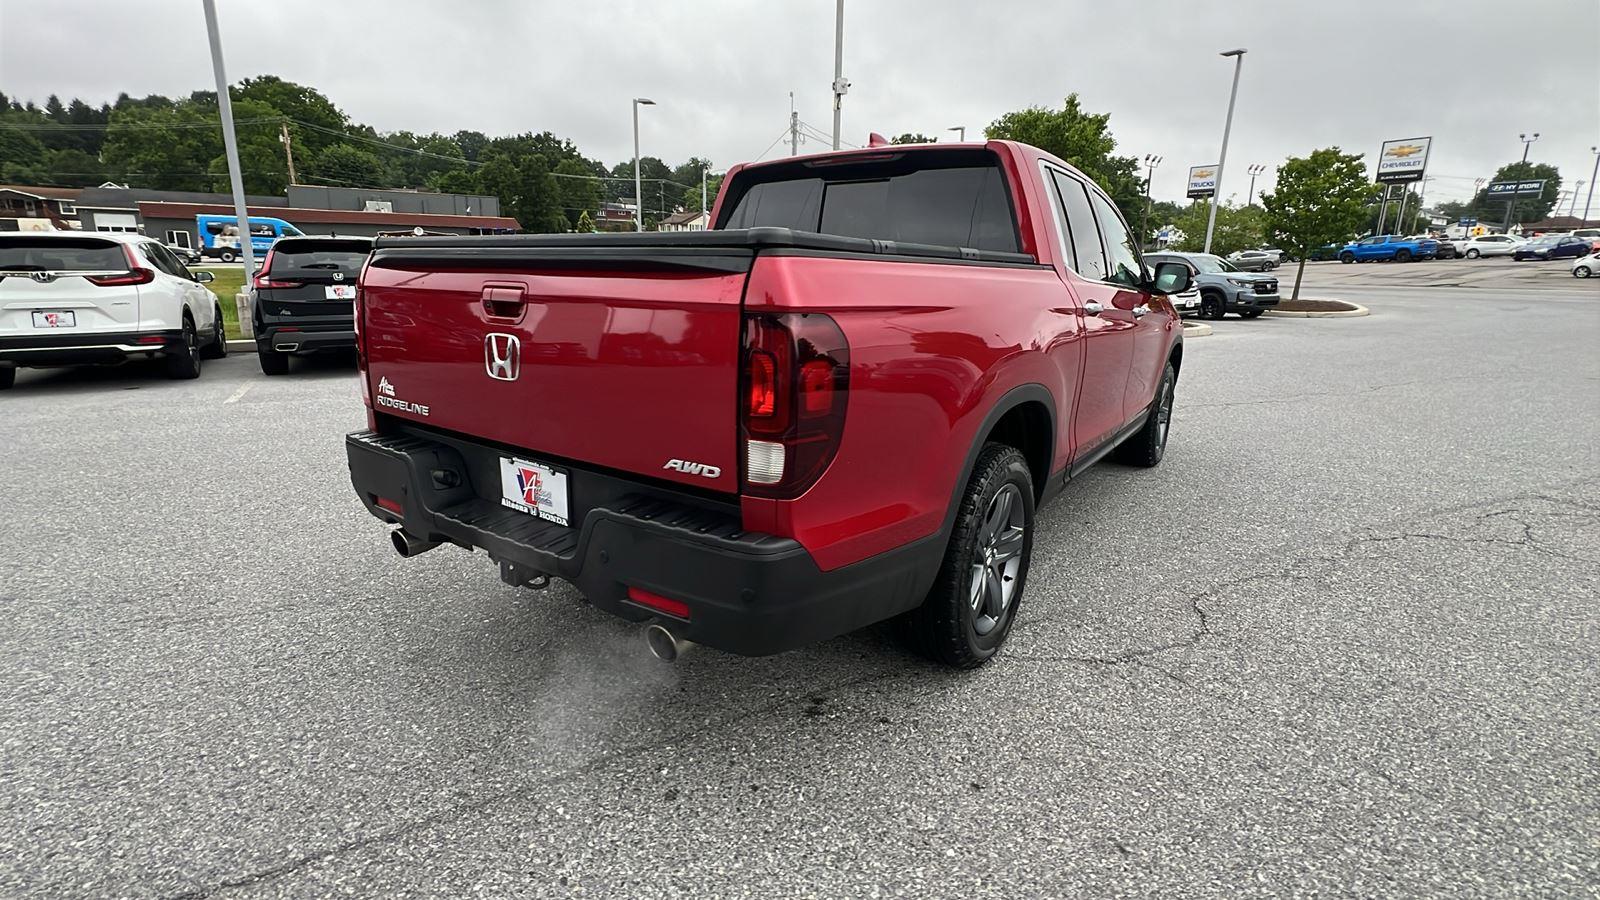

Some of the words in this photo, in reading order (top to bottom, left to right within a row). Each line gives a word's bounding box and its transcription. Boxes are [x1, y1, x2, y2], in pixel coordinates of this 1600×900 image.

[1382, 160, 1421, 169] CHEVROLET
[377, 395, 430, 416] RIDGELINE
[663, 459, 721, 478] AWD
[539, 511, 569, 527] HONDA
